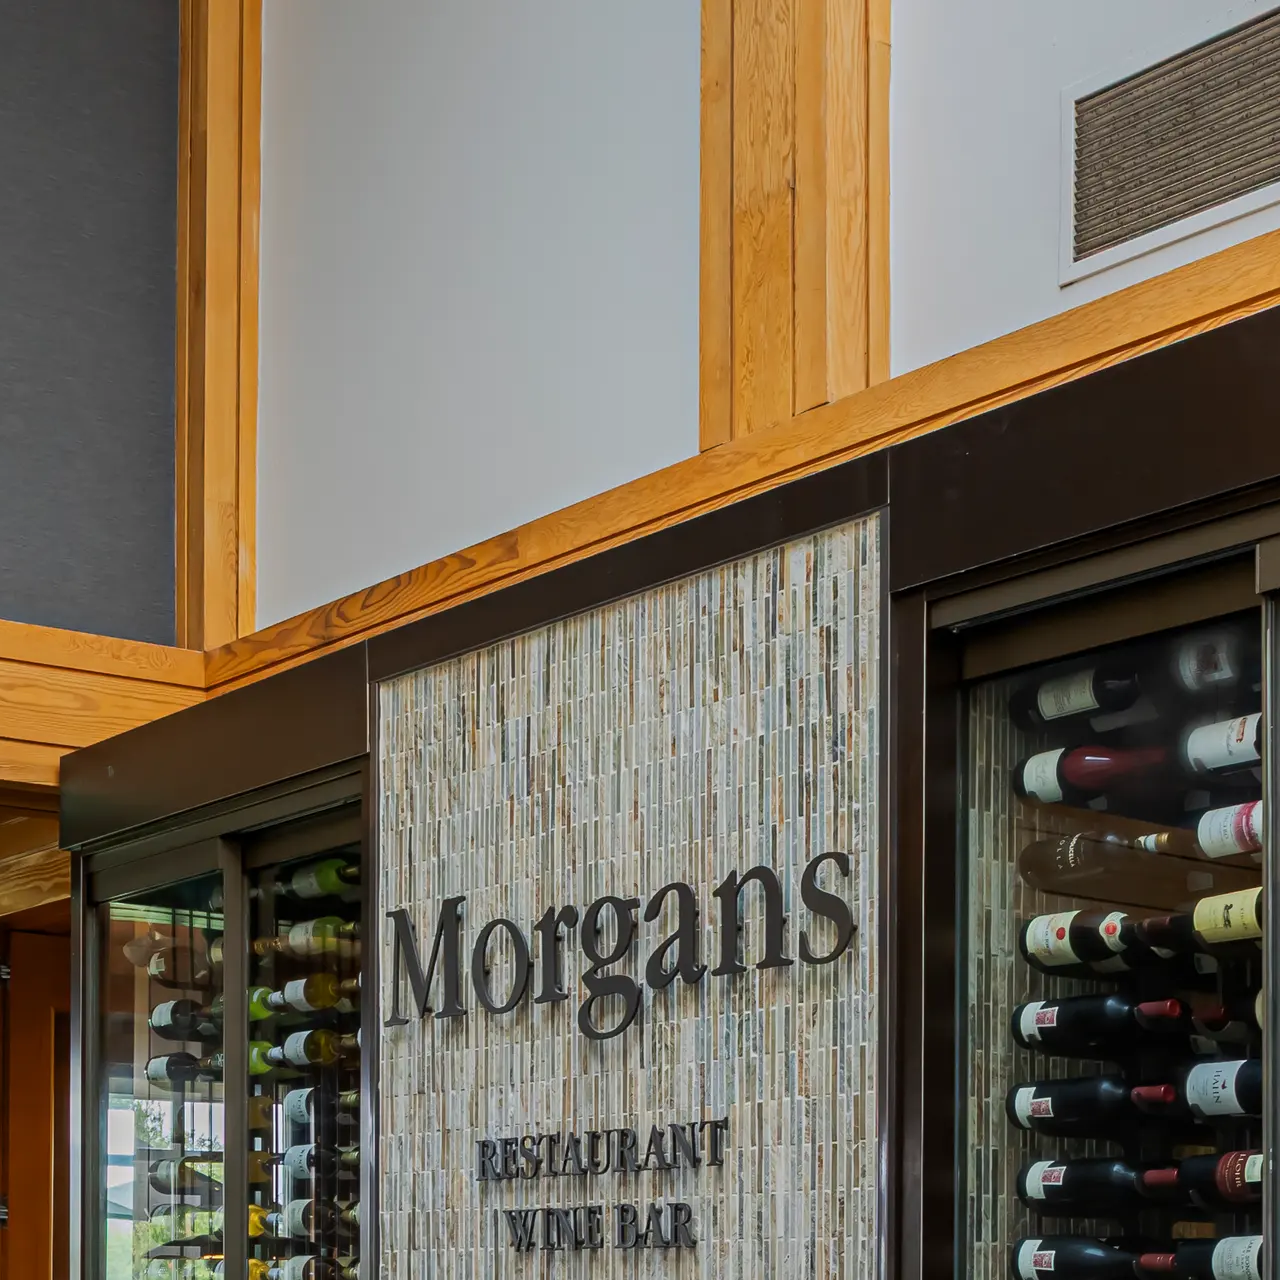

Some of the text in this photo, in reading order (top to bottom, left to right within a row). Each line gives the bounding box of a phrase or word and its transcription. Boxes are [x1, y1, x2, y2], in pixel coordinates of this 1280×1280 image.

[384, 851, 858, 1040] Morgans
[1212, 1070, 1223, 1104] HAHN
[476, 1116, 729, 1182] RESTAURANT
[504, 1202, 697, 1253] WINE BAR
